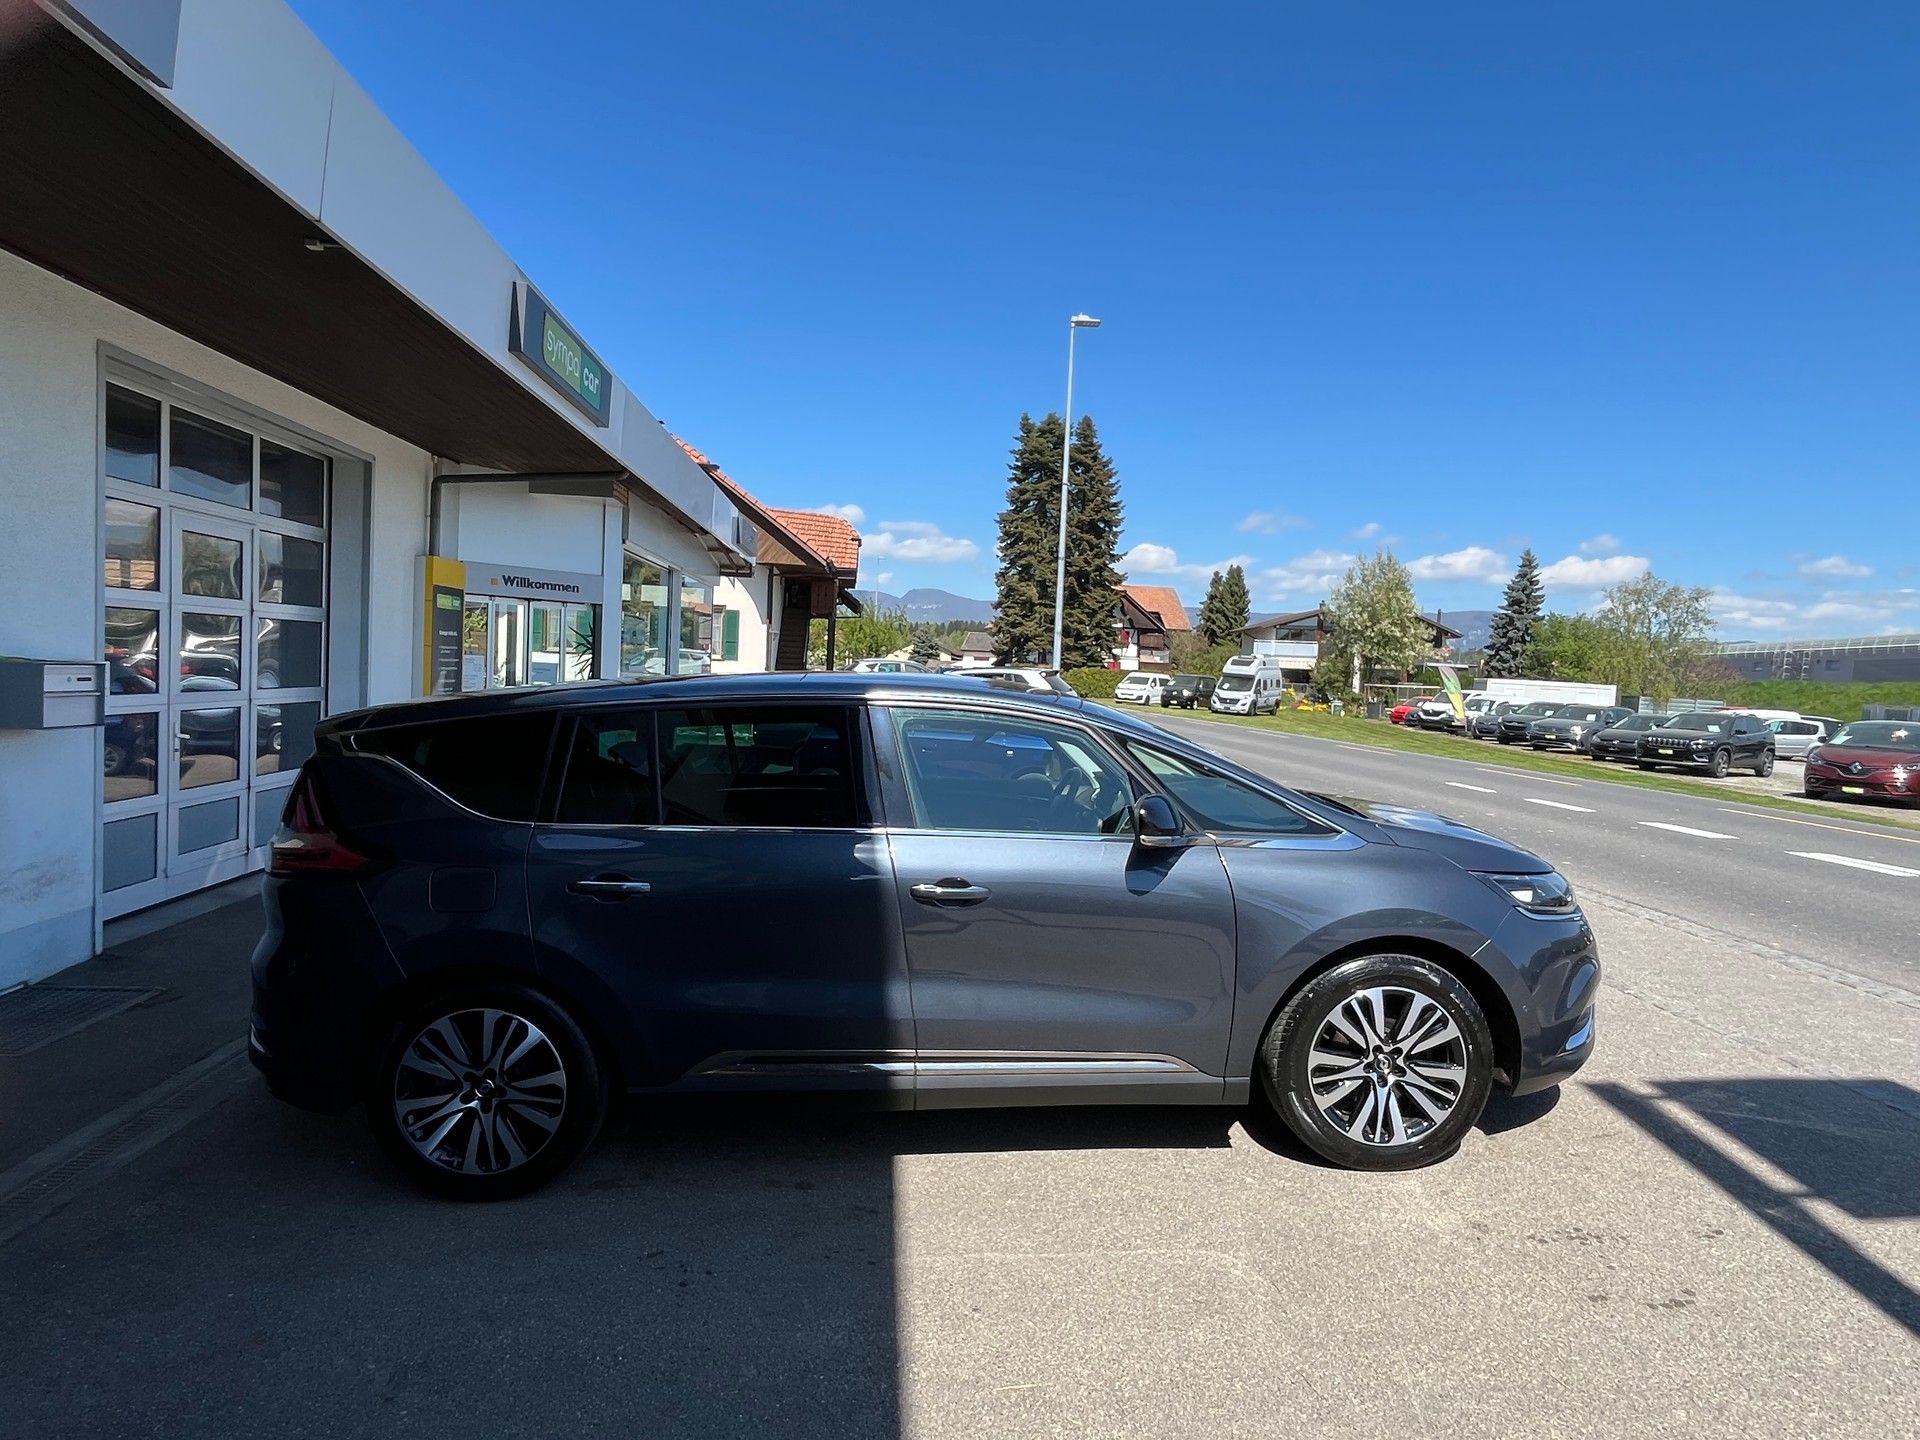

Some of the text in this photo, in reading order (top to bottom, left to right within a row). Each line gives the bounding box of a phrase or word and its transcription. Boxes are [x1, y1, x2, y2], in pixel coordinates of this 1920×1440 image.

[546, 329, 599, 394] sympa car
[501, 574, 580, 593] Willkommen
